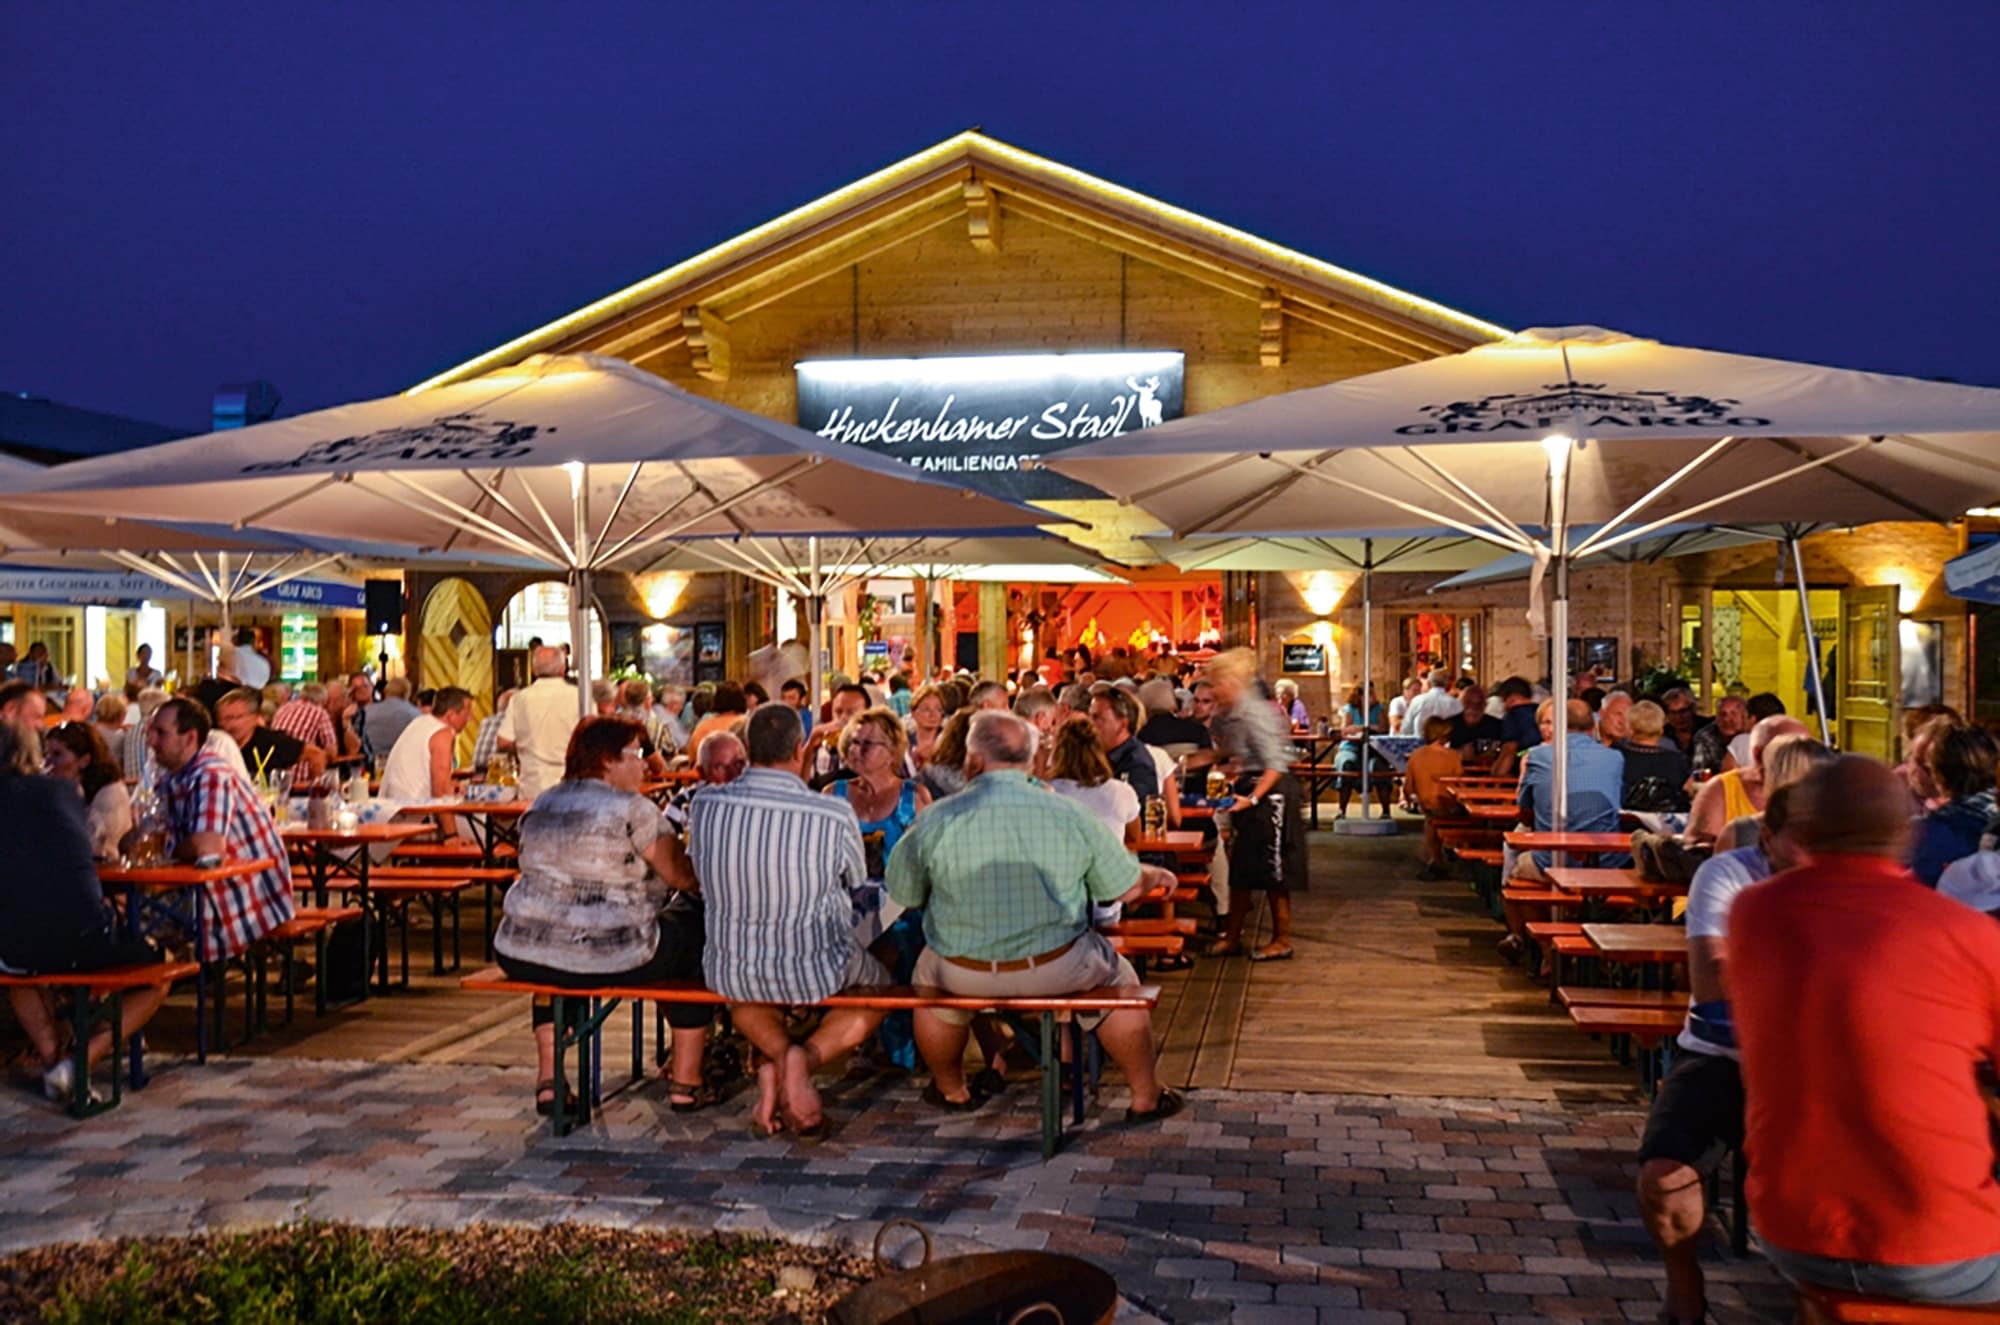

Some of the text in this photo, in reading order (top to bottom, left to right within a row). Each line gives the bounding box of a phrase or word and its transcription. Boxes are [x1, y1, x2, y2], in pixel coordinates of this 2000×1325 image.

[815, 394, 1137, 443] Huckenhamer Stadl
[1586, 415, 1773, 427] ARCO
